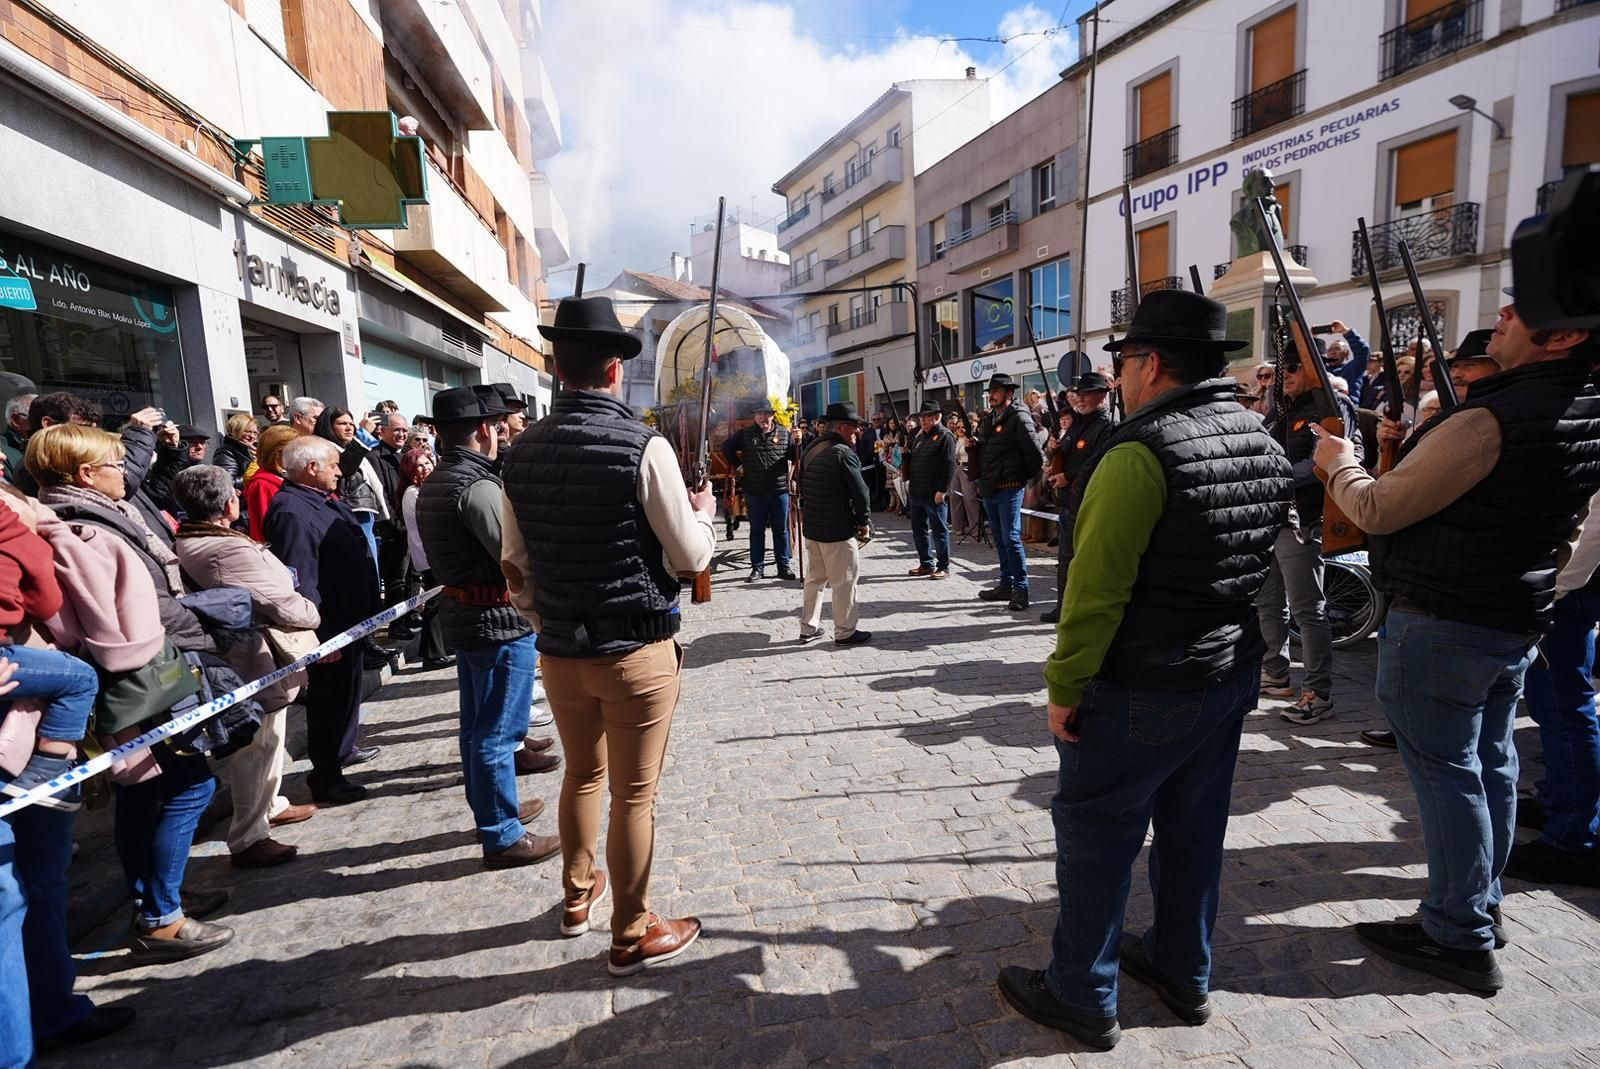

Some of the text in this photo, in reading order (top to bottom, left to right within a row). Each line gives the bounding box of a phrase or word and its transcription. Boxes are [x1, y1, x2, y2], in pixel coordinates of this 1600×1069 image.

[1242, 98, 1400, 165] INDUSTRIAS PECUARIAS
[1284, 128, 1360, 164] PEDROCHES
[1188, 161, 1228, 195] IPP
[15, 254, 44, 280] AL
[49, 263, 91, 292] AÑO
[232, 239, 341, 316] farmacia
[70, 302, 96, 315] Antonio
[97, 308, 111, 319] Blas
[112, 313, 132, 325] Molina
